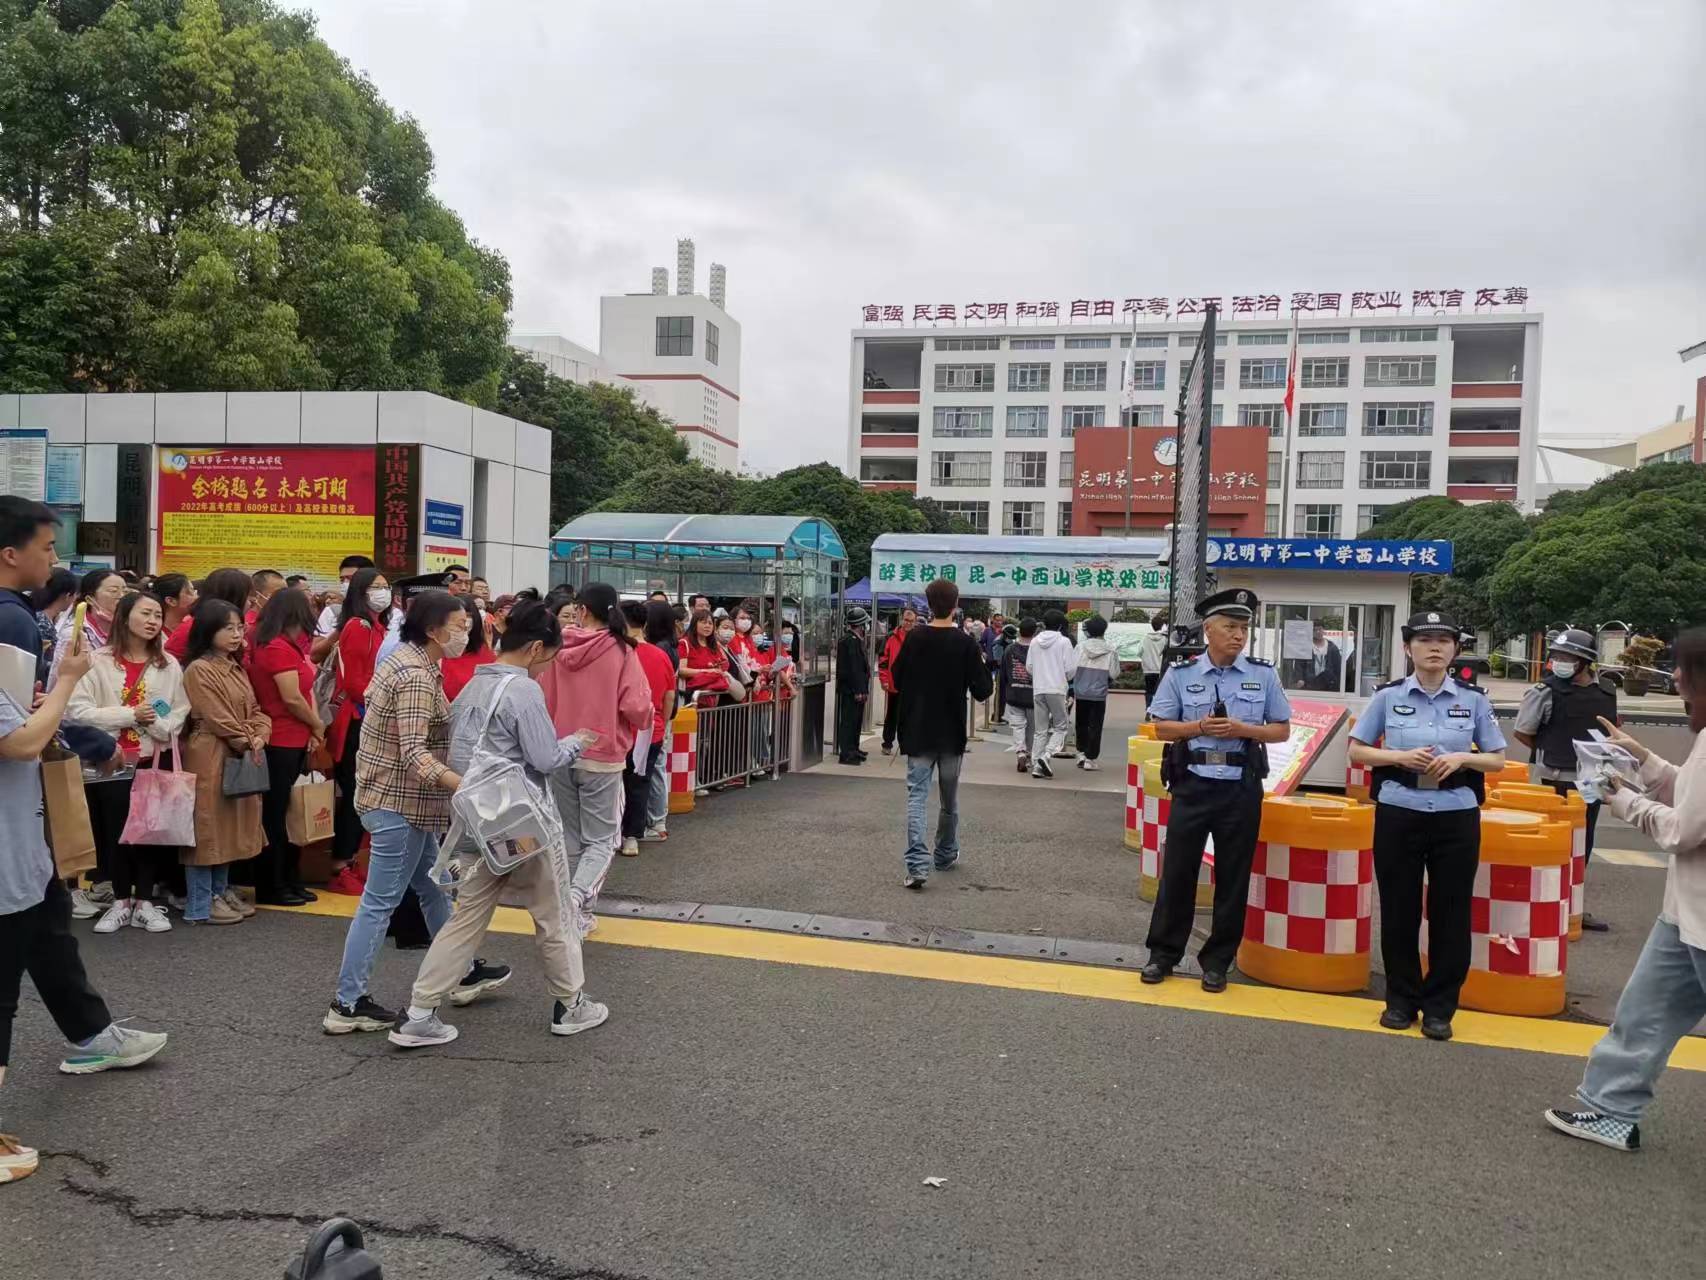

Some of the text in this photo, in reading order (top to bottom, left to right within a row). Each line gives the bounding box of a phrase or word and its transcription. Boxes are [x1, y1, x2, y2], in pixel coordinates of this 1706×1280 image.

[863, 286, 1528, 321] 富强 民主 文明 和谐 自由 平等 公正 法治 爱国 敬业 诚信 友善
[192, 474, 349, 500] 金榜题名 未来可期
[1079, 469, 1261, 489] 昆明第一中山学校
[1222, 542, 1440, 566] 昆明市第一中学西山学校
[879, 563, 957, 583] 醉美校园
